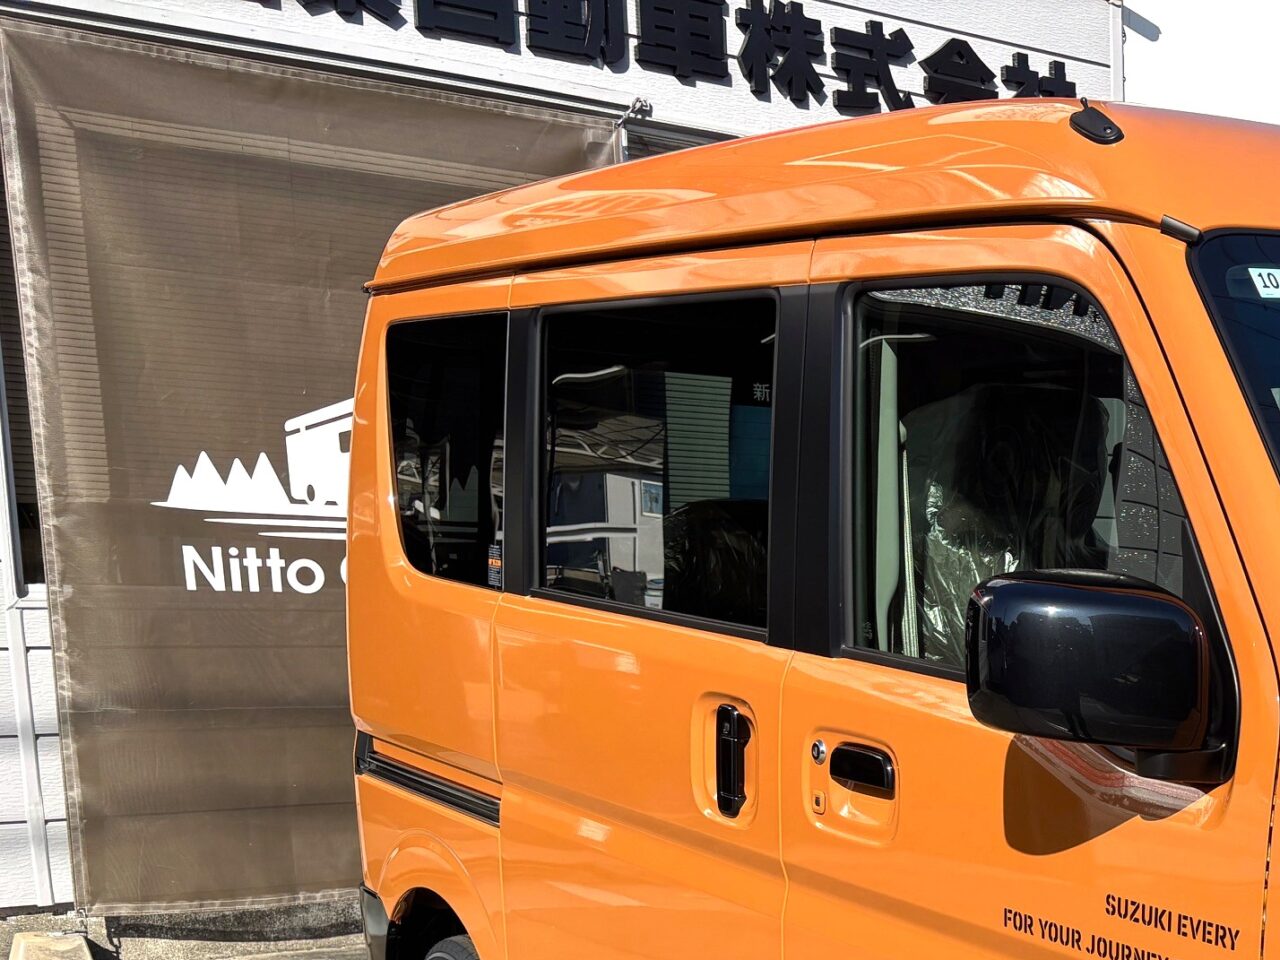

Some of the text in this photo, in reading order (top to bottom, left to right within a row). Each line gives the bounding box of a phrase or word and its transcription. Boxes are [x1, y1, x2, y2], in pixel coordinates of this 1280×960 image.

[1257, 272, 1280, 289] 10
[181, 545, 326, 595] Nitto
[1003, 907, 1034, 936] FOR
[1038, 917, 1082, 951] YOUR
[1105, 893, 1240, 951] SUZUKI EVERY
